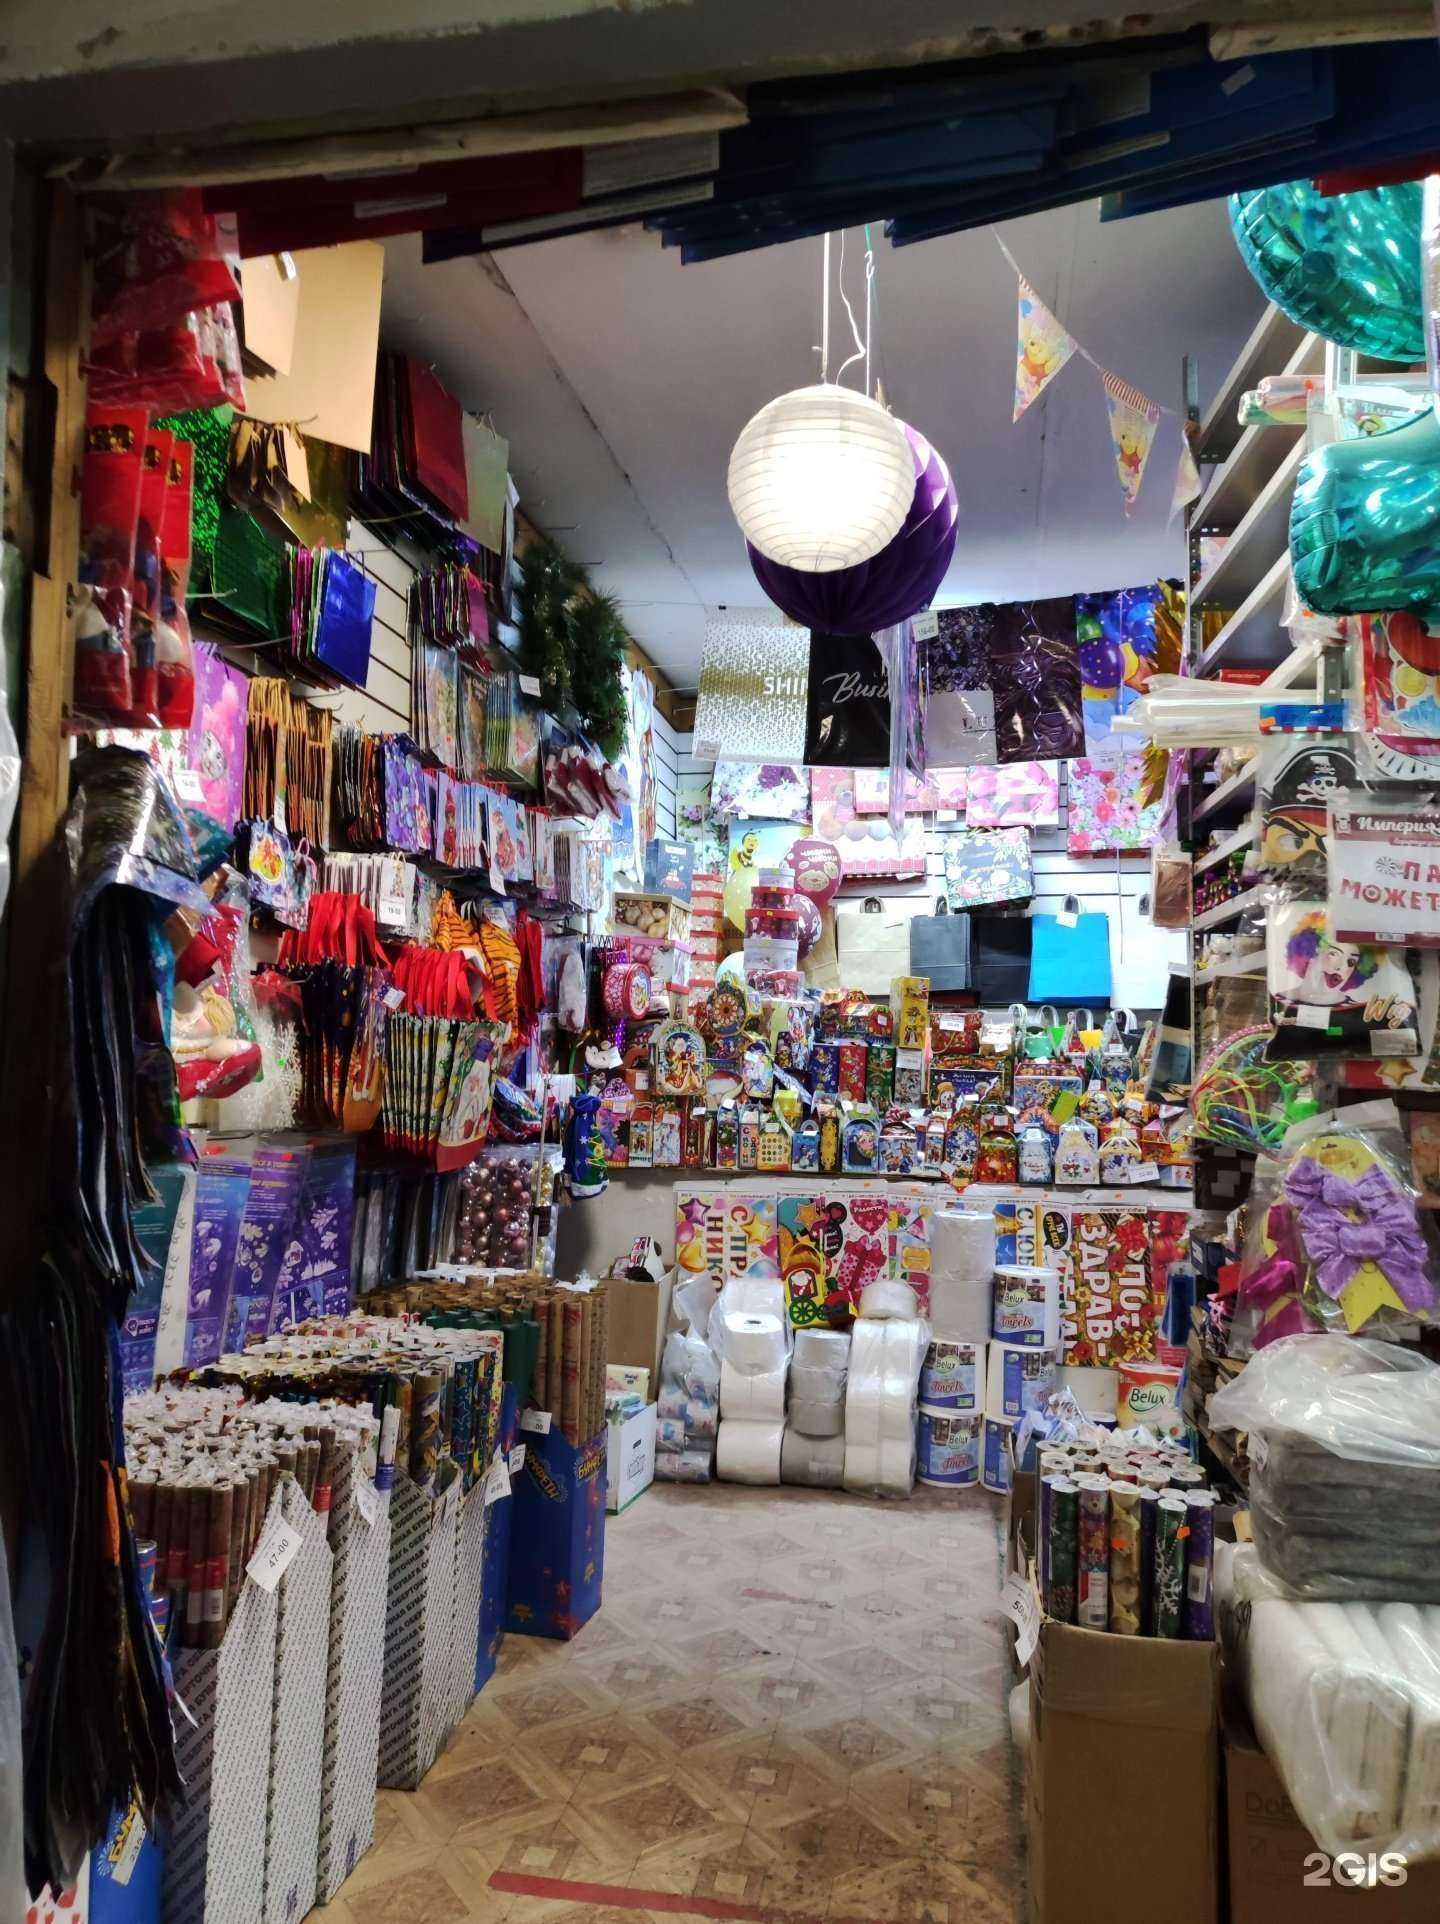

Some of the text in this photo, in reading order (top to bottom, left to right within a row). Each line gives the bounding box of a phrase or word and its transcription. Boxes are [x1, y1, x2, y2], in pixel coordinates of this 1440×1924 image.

[1340, 878, 1440, 912] МОЖЕТ
[1362, 991, 1413, 1031] Wig
[730, 1235, 748, 1279] ПР
[1131, 1387, 1166, 1406] Belux
[268, 1538, 289, 1569] 47-00
